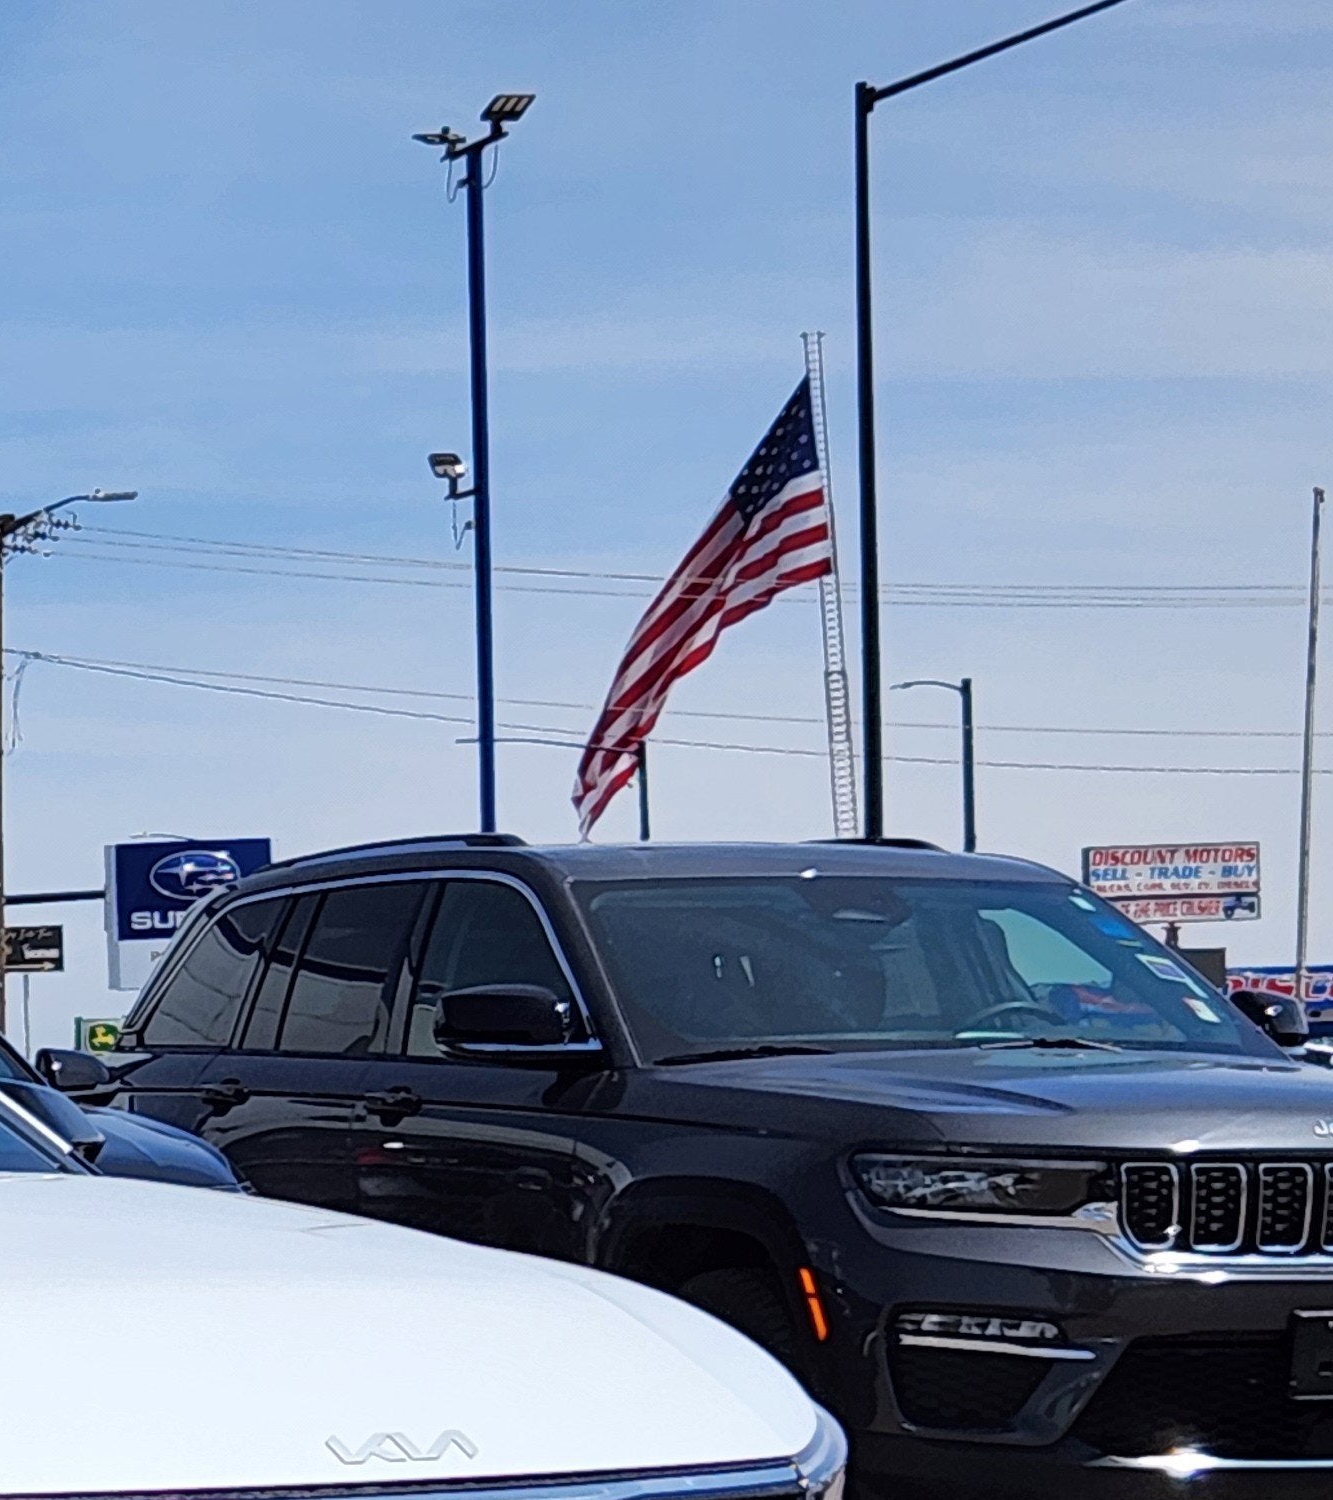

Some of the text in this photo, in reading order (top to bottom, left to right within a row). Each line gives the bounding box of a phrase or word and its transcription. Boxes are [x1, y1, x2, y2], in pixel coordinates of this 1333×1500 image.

[1091, 847, 1257, 867] DISCOUNT MOTORS
[1091, 867, 1130, 882] SELL
[1149, 865, 1204, 880] TRADE
[1220, 864, 1257, 879] BUY
